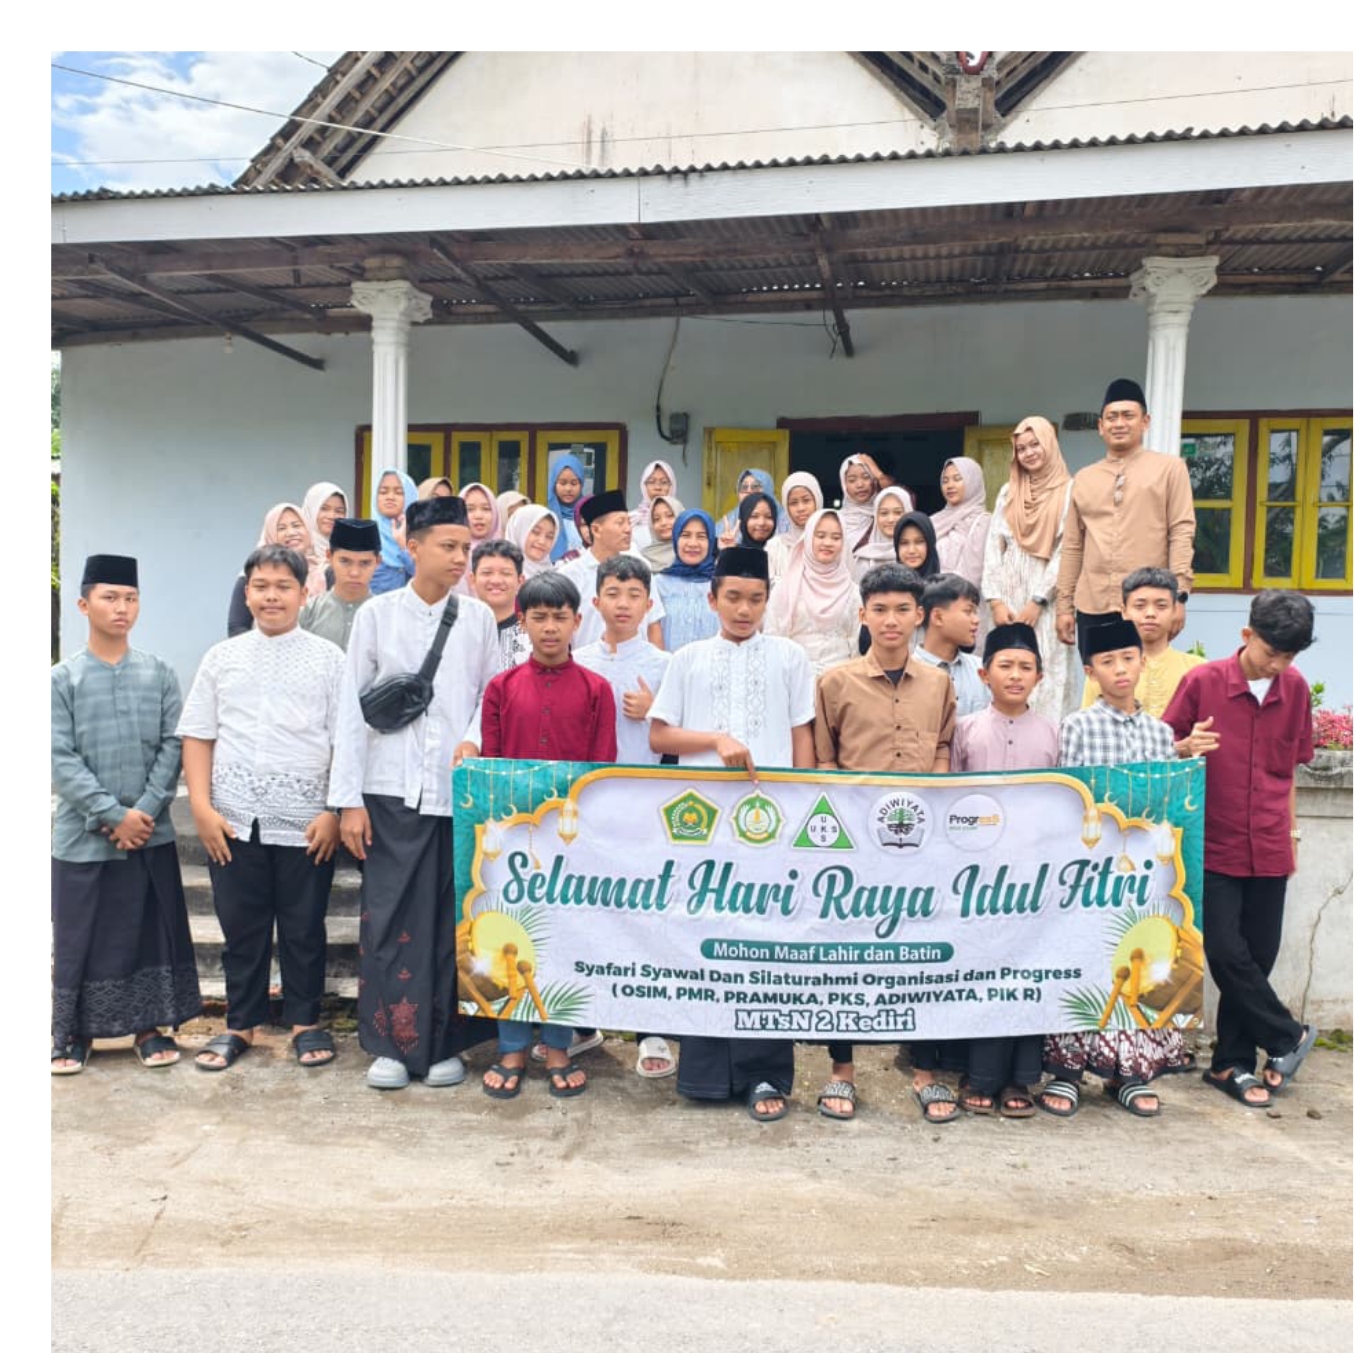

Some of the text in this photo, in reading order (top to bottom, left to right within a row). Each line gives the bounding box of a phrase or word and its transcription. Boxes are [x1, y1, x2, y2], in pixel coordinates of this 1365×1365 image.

[876, 798, 926, 824] ADIWIYATA
[502, 850, 1155, 939] Selamat Hari Raya Idul Fitri
[713, 942, 942, 962] Mohon Maaf Lahir dan Batin
[574, 960, 1082, 990] Syafari Syawal Dan Silaturahmi Organisasi dan Progress
[676, 986, 721, 1004] PMR,
[723, 990, 824, 1008] PRAMUKA,
[827, 992, 871, 1008] PKS,
[874, 988, 983, 1007] ADIWIYATA,
[986, 987, 1020, 1003] PIK
[1022, 986, 1042, 1003] R)
[734, 1007, 917, 1032] MTsN 2 Kediri
